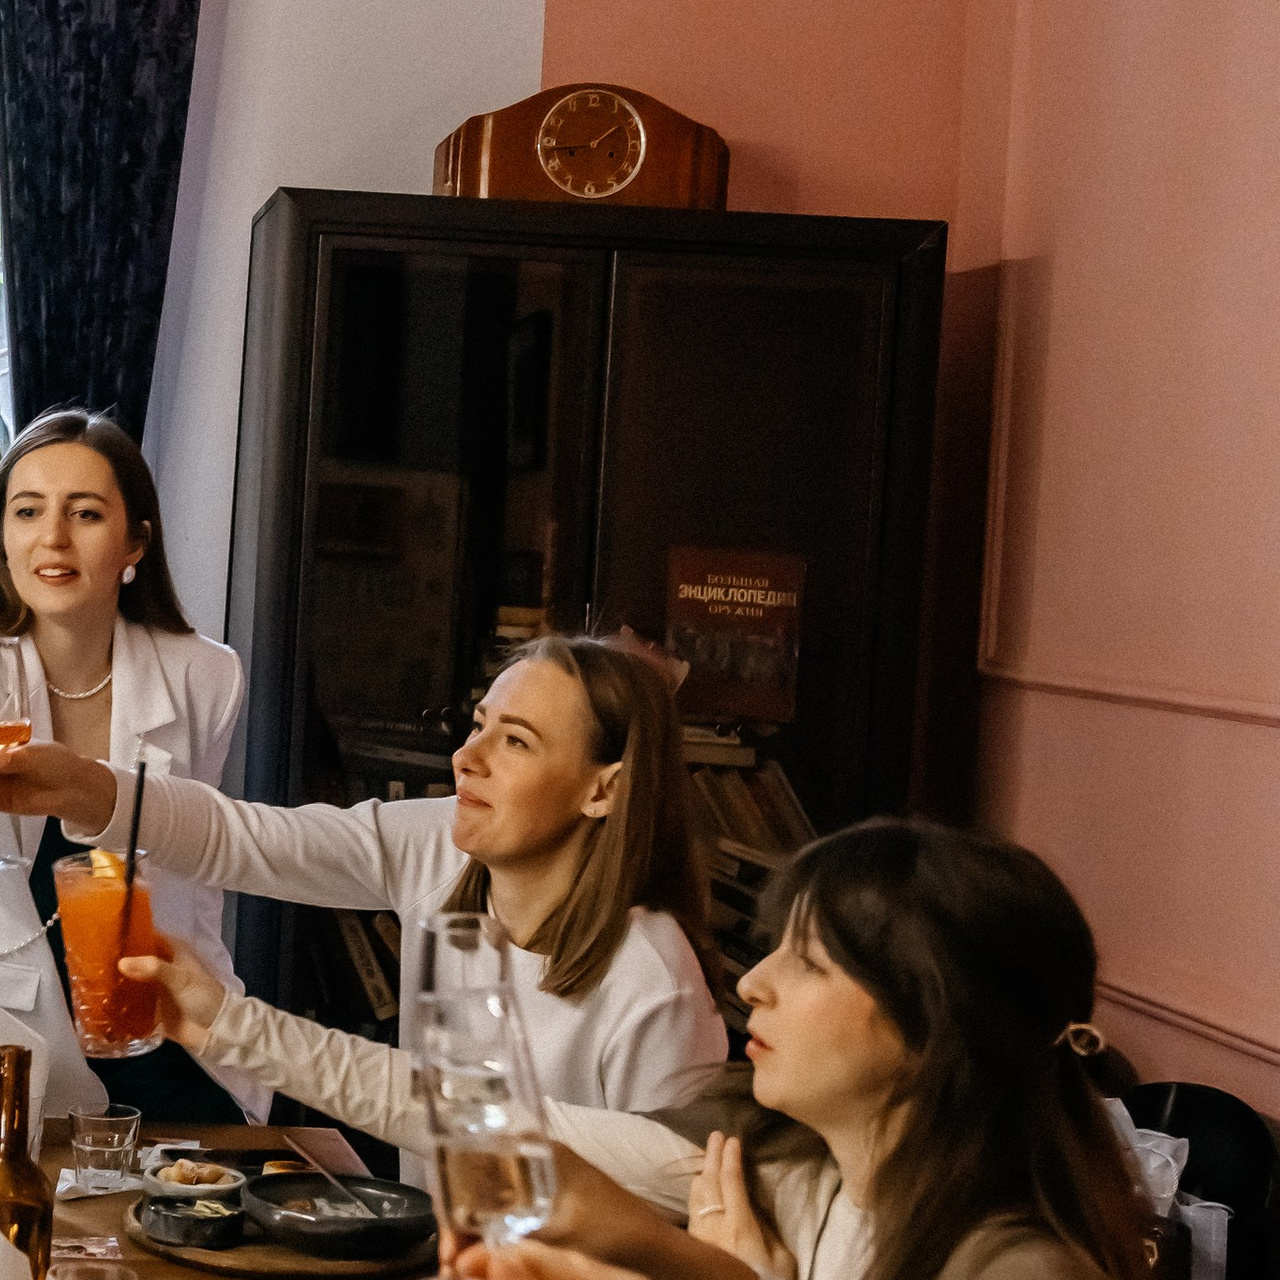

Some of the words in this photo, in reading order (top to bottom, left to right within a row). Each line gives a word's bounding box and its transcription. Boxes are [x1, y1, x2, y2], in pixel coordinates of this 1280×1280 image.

[567, 99, 577, 112] 11
[586, 93, 600, 107] 12
[564, 175, 573, 190] 7
[584, 180, 595, 195] 6
[707, 574, 769, 588] БОЛЬШАЯ
